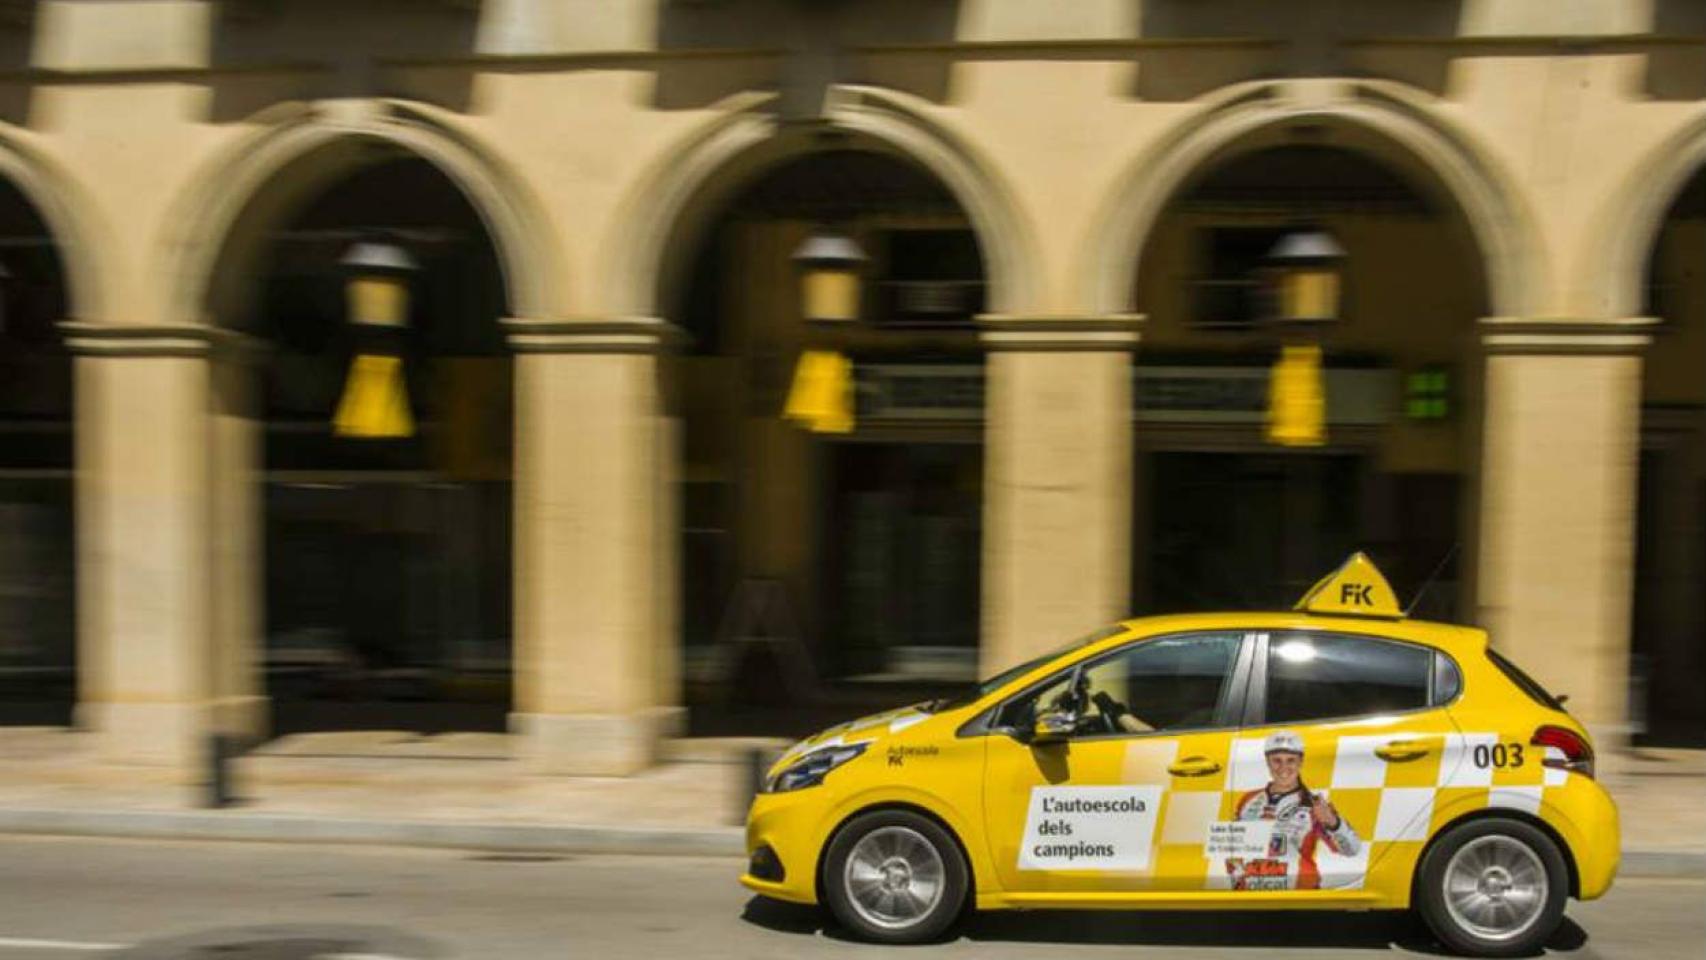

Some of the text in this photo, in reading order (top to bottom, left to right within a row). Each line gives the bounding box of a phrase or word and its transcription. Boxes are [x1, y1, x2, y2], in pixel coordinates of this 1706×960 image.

[1473, 743, 1524, 769] 003
[1042, 796, 1146, 813] L'autoescola
[1037, 819, 1073, 835] dels
[1033, 841, 1115, 860] campions
